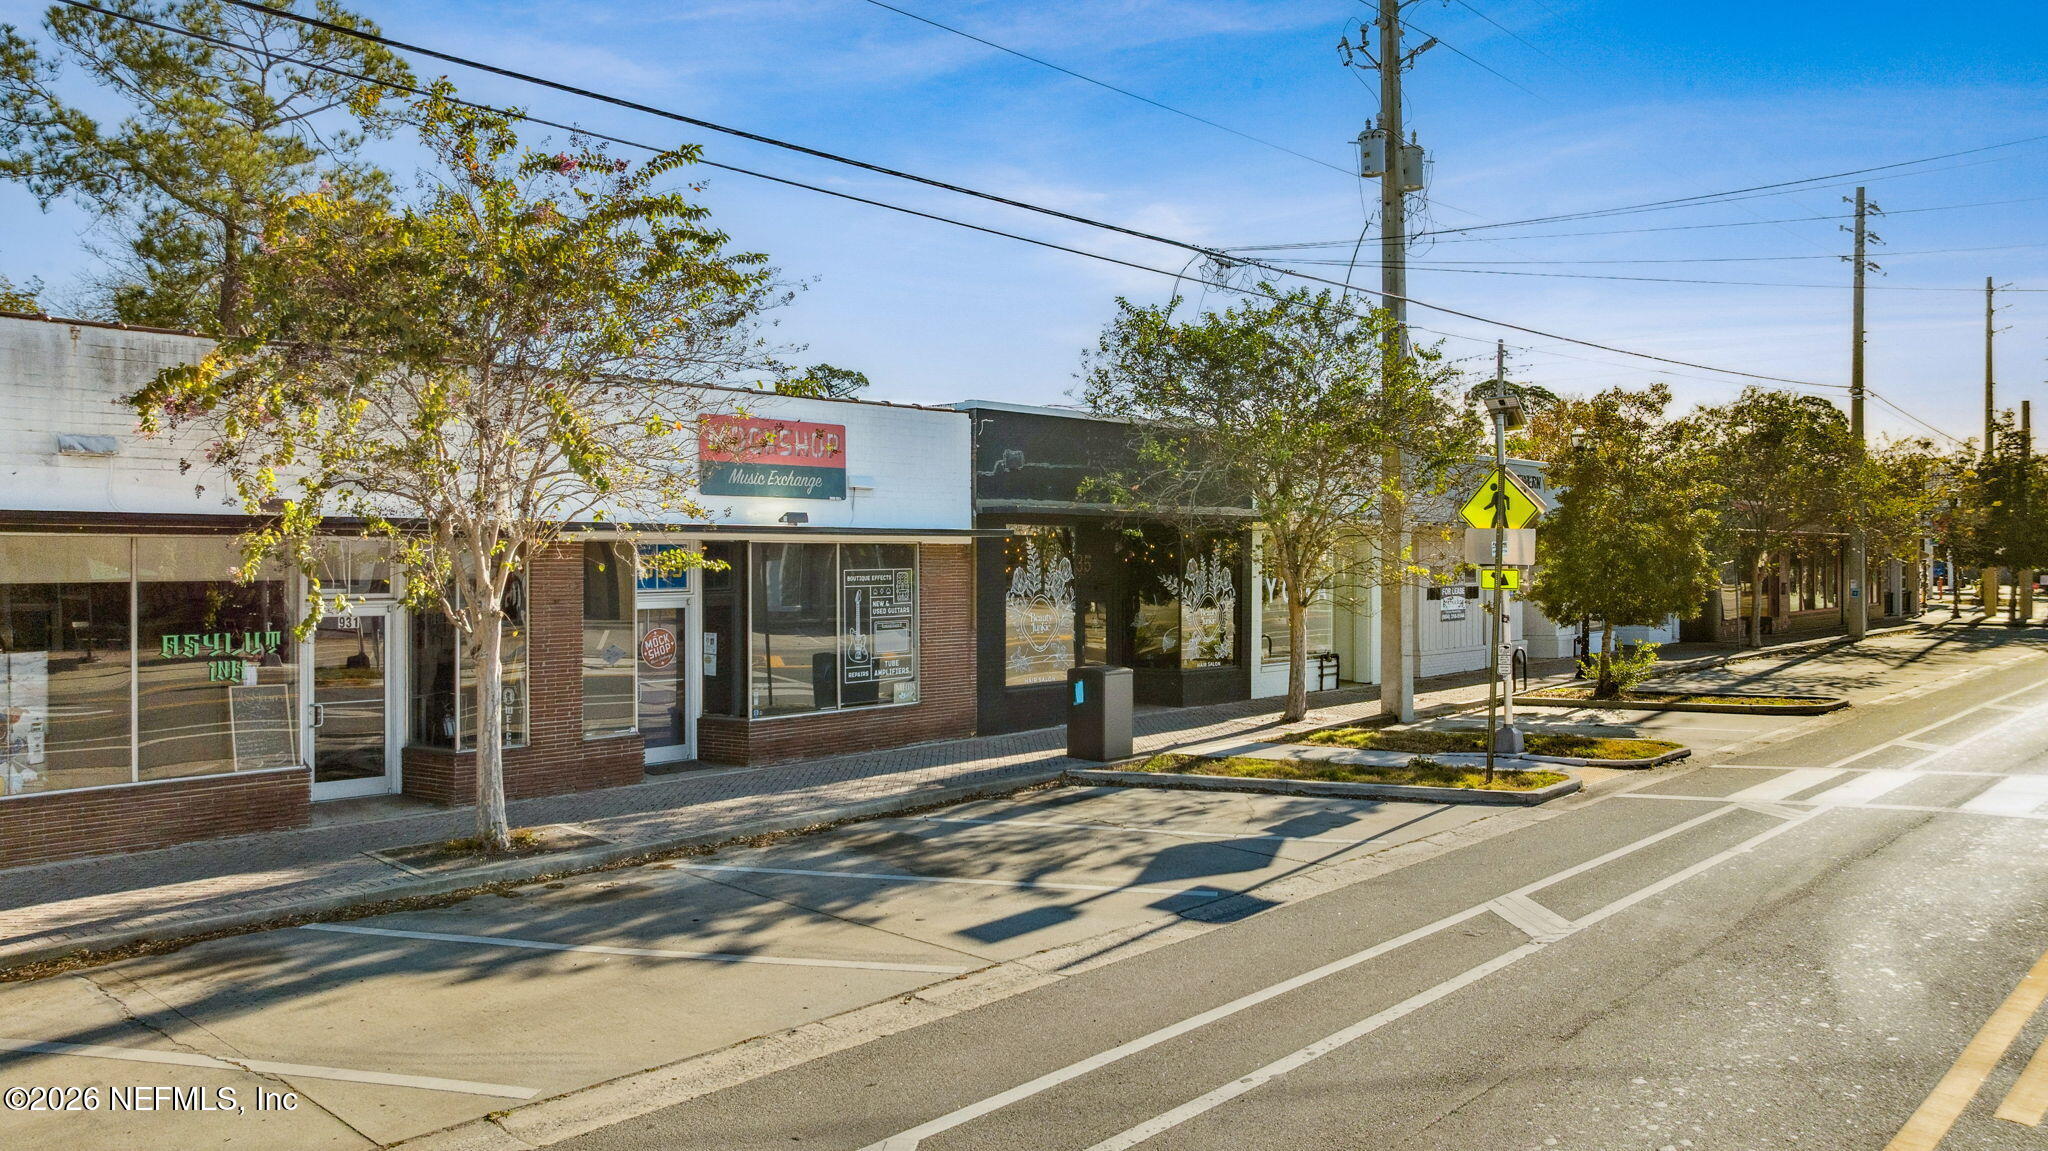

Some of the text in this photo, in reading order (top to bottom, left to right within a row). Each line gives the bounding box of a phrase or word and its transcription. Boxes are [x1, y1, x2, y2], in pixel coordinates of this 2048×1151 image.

[728, 468, 823, 495] Music Exchange
[1441, 586, 1466, 596] FOR LEASE
[339, 616, 359, 628] 931
[644, 633, 671, 650] MOCK
[647, 643, 672, 660] SHOP
[207, 659, 249, 683] INK
[873, 667, 910, 677] AMPLIFIERS
